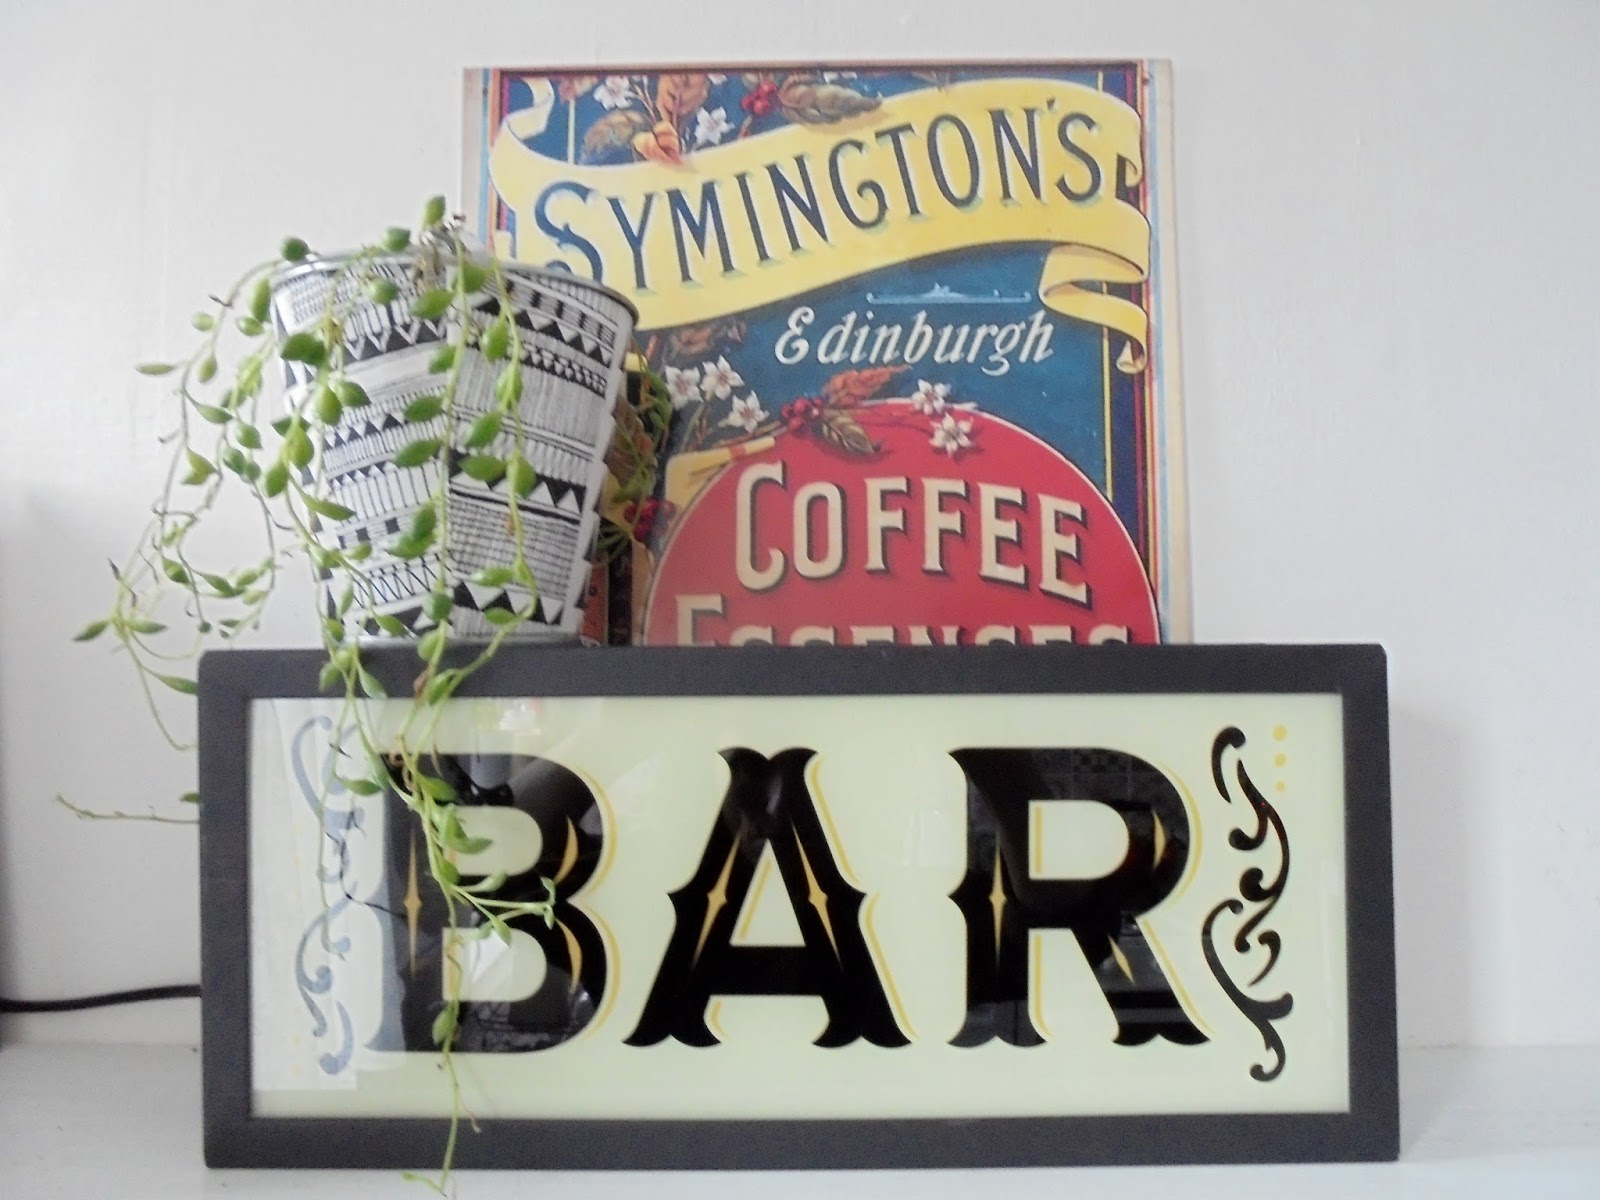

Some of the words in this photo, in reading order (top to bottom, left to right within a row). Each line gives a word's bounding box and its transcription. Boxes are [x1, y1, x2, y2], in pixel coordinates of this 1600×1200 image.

[534, 97, 1102, 291] SYMINGTON'S
[774, 306, 1054, 377] Edinburgh
[735, 460, 1091, 606] COFFEE
[363, 746, 1210, 1053] BAR
